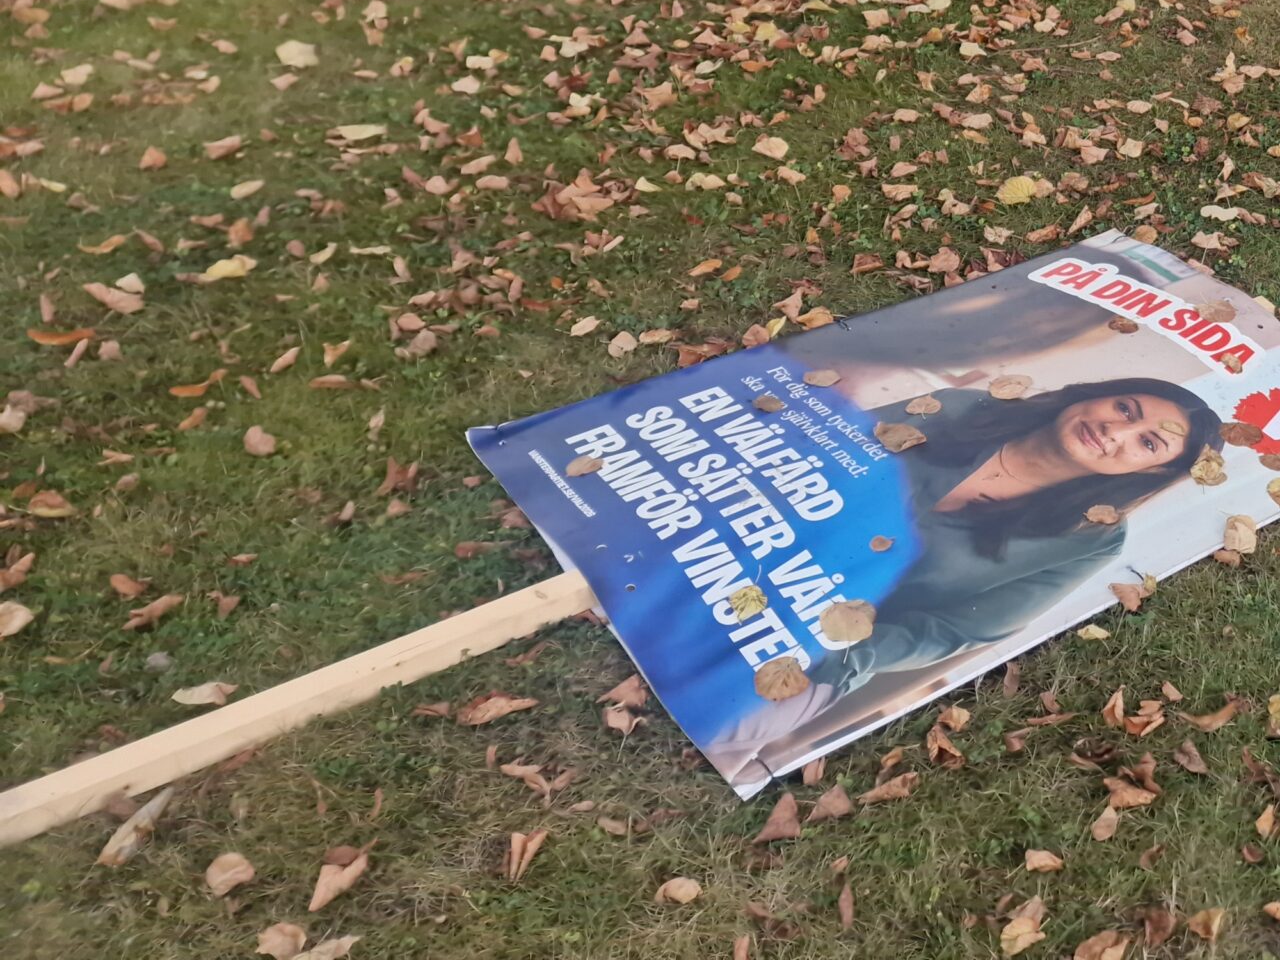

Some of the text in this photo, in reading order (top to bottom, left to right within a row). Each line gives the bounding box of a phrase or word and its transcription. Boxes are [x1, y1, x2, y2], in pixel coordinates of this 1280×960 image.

[1040, 262, 1256, 375] PÅ DIN SIDA
[740, 376, 765, 392] ska
[766, 366, 793, 382] För
[786, 383, 810, 399] dig
[803, 397, 832, 416] som
[825, 415, 868, 445] tycker
[862, 441, 888, 461] det
[565, 424, 703, 541] FRAMFÖR
[625, 406, 700, 463] SOM
[677, 444, 796, 560] SÄTTER
[678, 386, 845, 522] EN VÄLFÄRD
[780, 410, 869, 478] självklart med:
